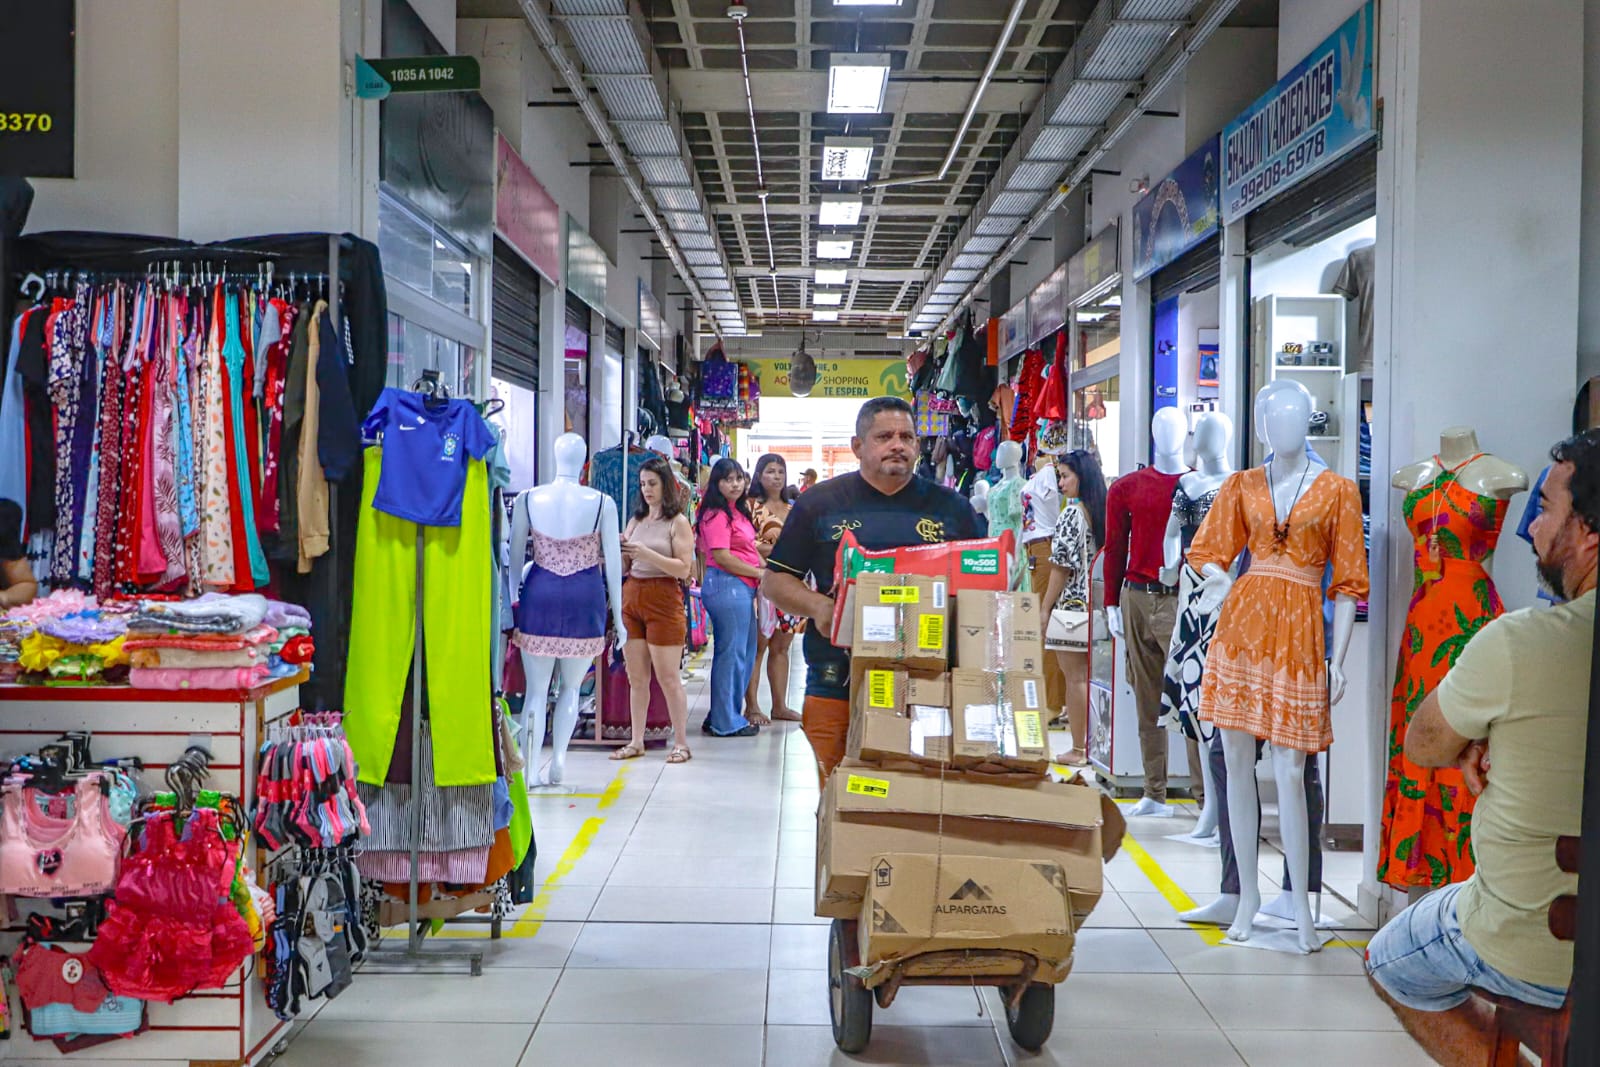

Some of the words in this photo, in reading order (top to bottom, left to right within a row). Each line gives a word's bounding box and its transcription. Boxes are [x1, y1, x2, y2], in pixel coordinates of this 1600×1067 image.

[390, 69, 417, 81] 1035
[419, 69, 426, 80] A
[428, 67, 454, 79] 1042
[1227, 108, 1264, 187] SHALOM
[1266, 54, 1333, 158] VARIEDADES
[823, 376, 869, 385] SHOPPING
[824, 387, 834, 396] TE
[836, 387, 868, 396] ESPERA
[935, 904, 1007, 915] ALPARGATAS
